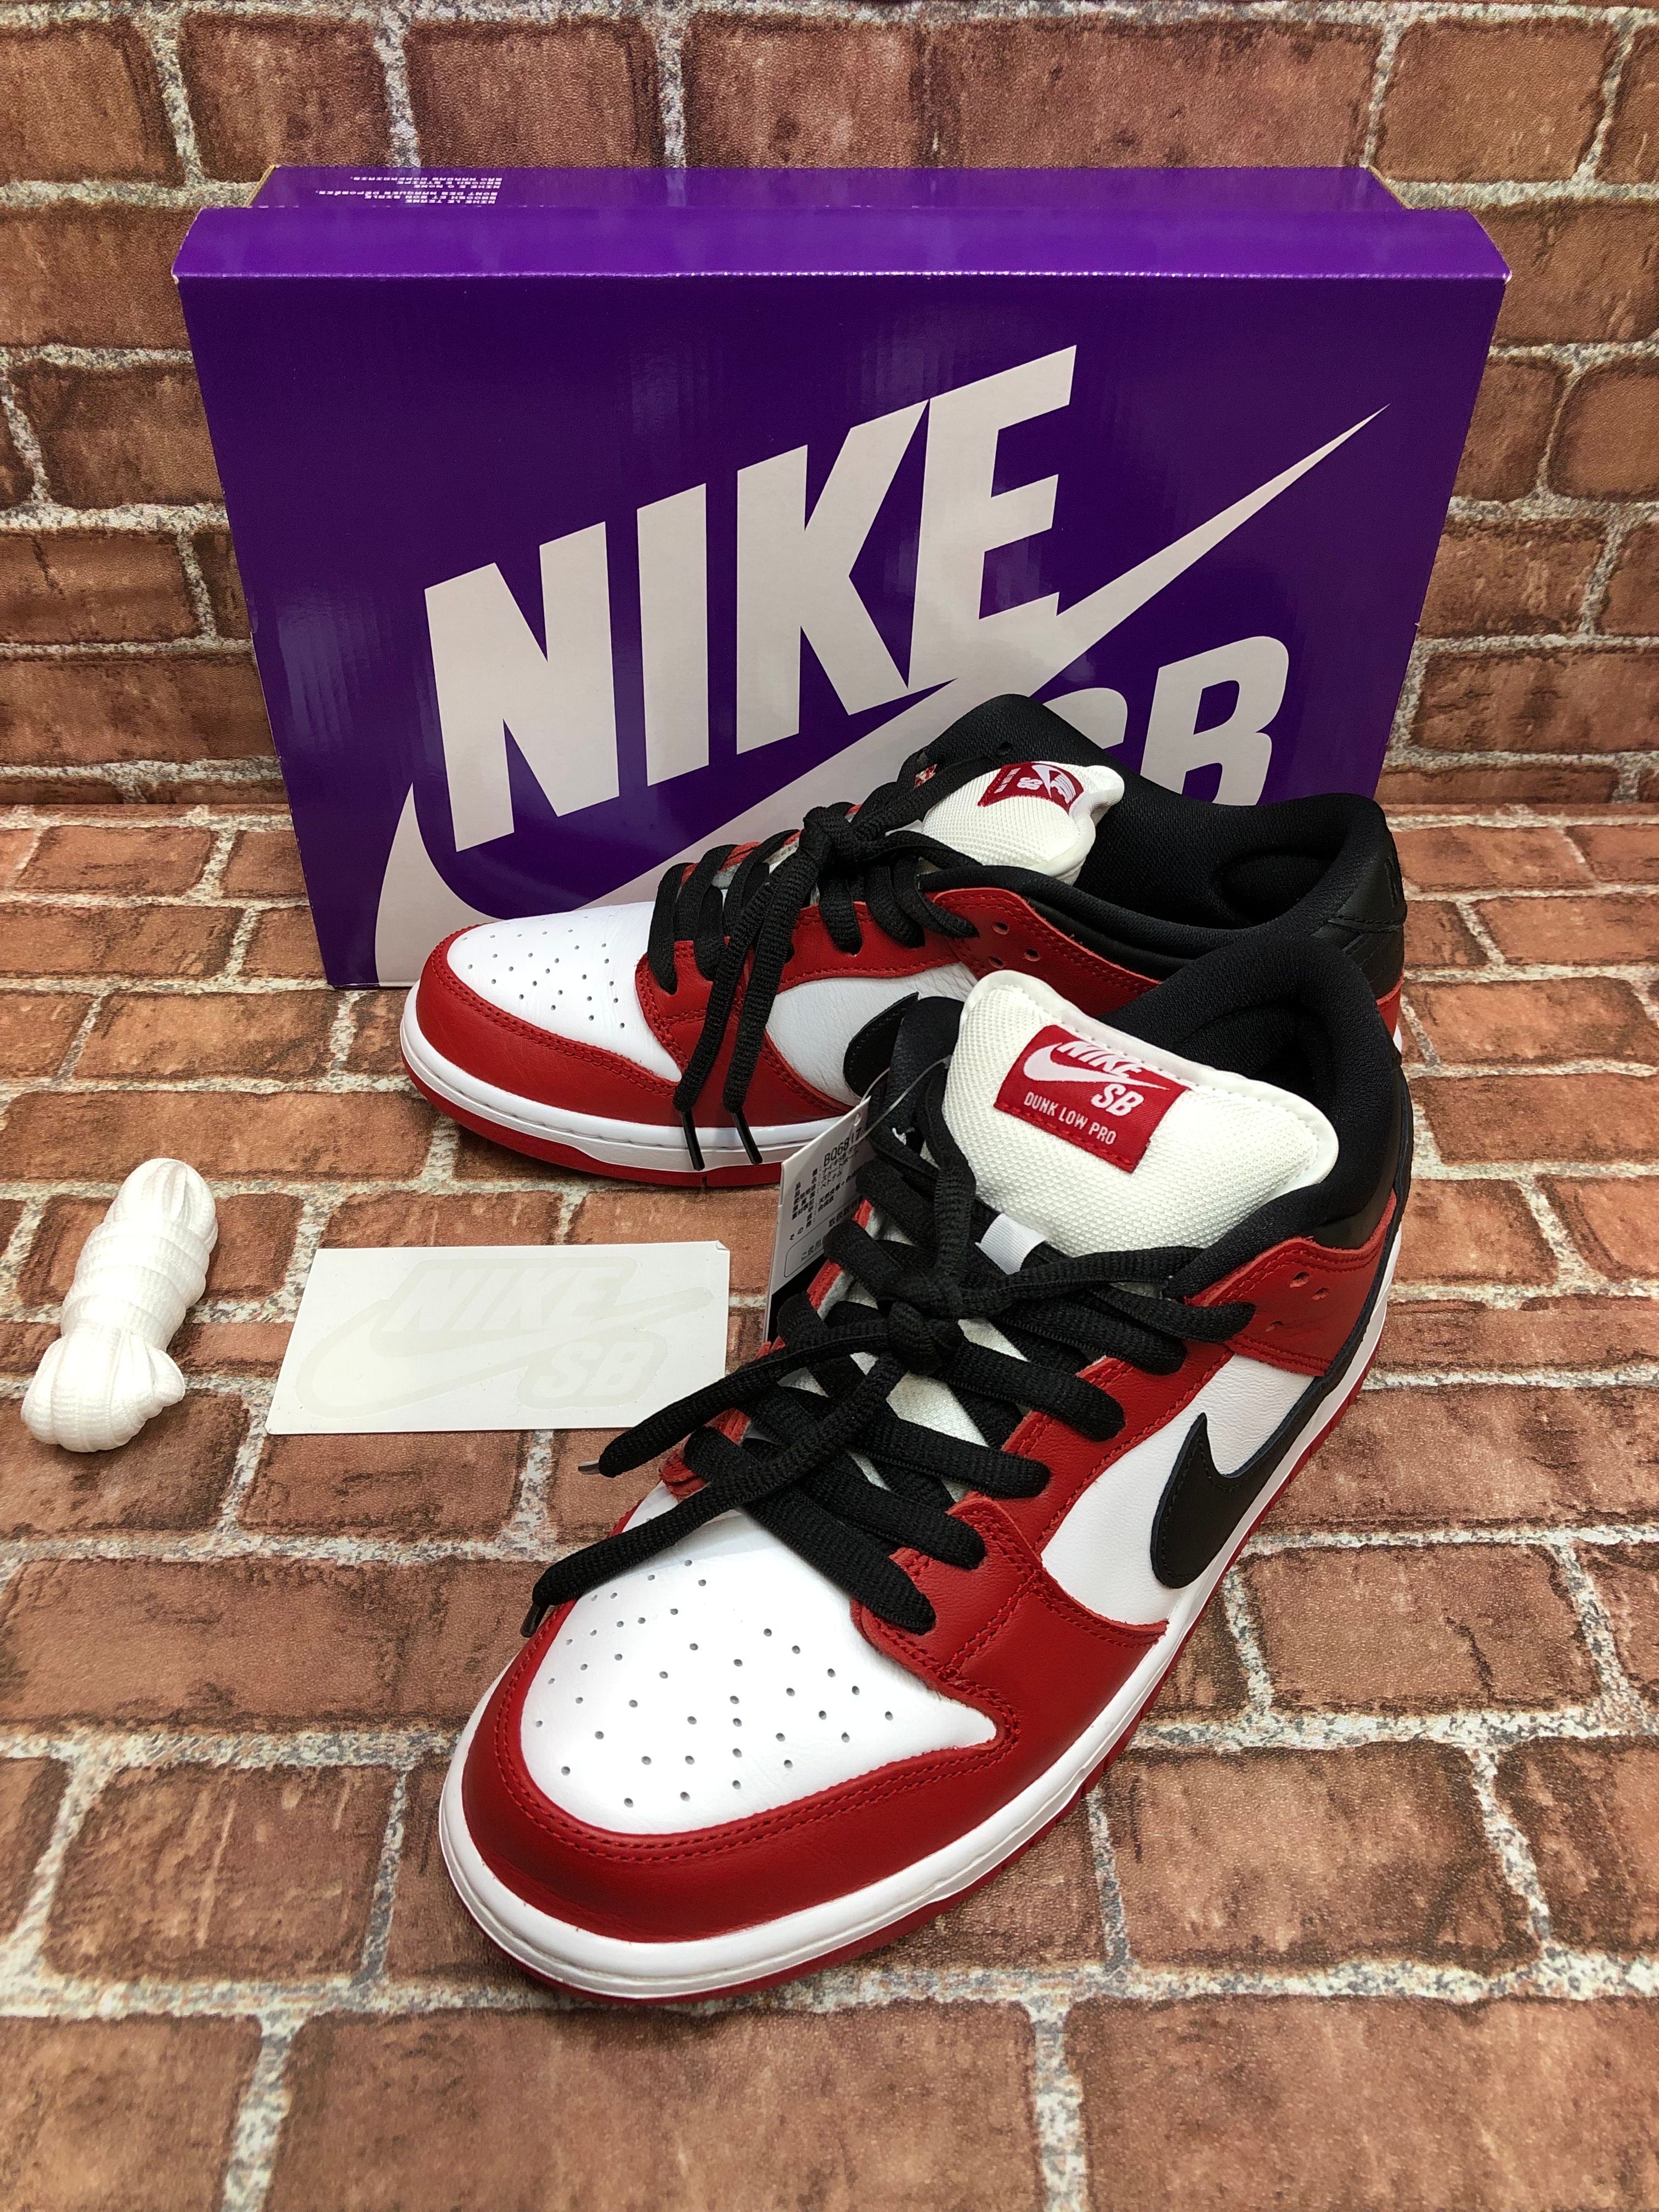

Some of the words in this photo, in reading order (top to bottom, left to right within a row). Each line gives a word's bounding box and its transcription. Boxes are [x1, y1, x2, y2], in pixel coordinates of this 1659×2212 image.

[425, 345, 1077, 852] NIKE
[1056, 1040, 1142, 1079] NIKE
[1023, 1091, 1059, 1116] DUNK
[1058, 1107, 1088, 1130] LOW
[1088, 1122, 1117, 1145] PRO
[1090, 1084, 1144, 1116] SB
[381, 1265, 614, 1333] NIKE
[532, 1341, 655, 1397] SB
